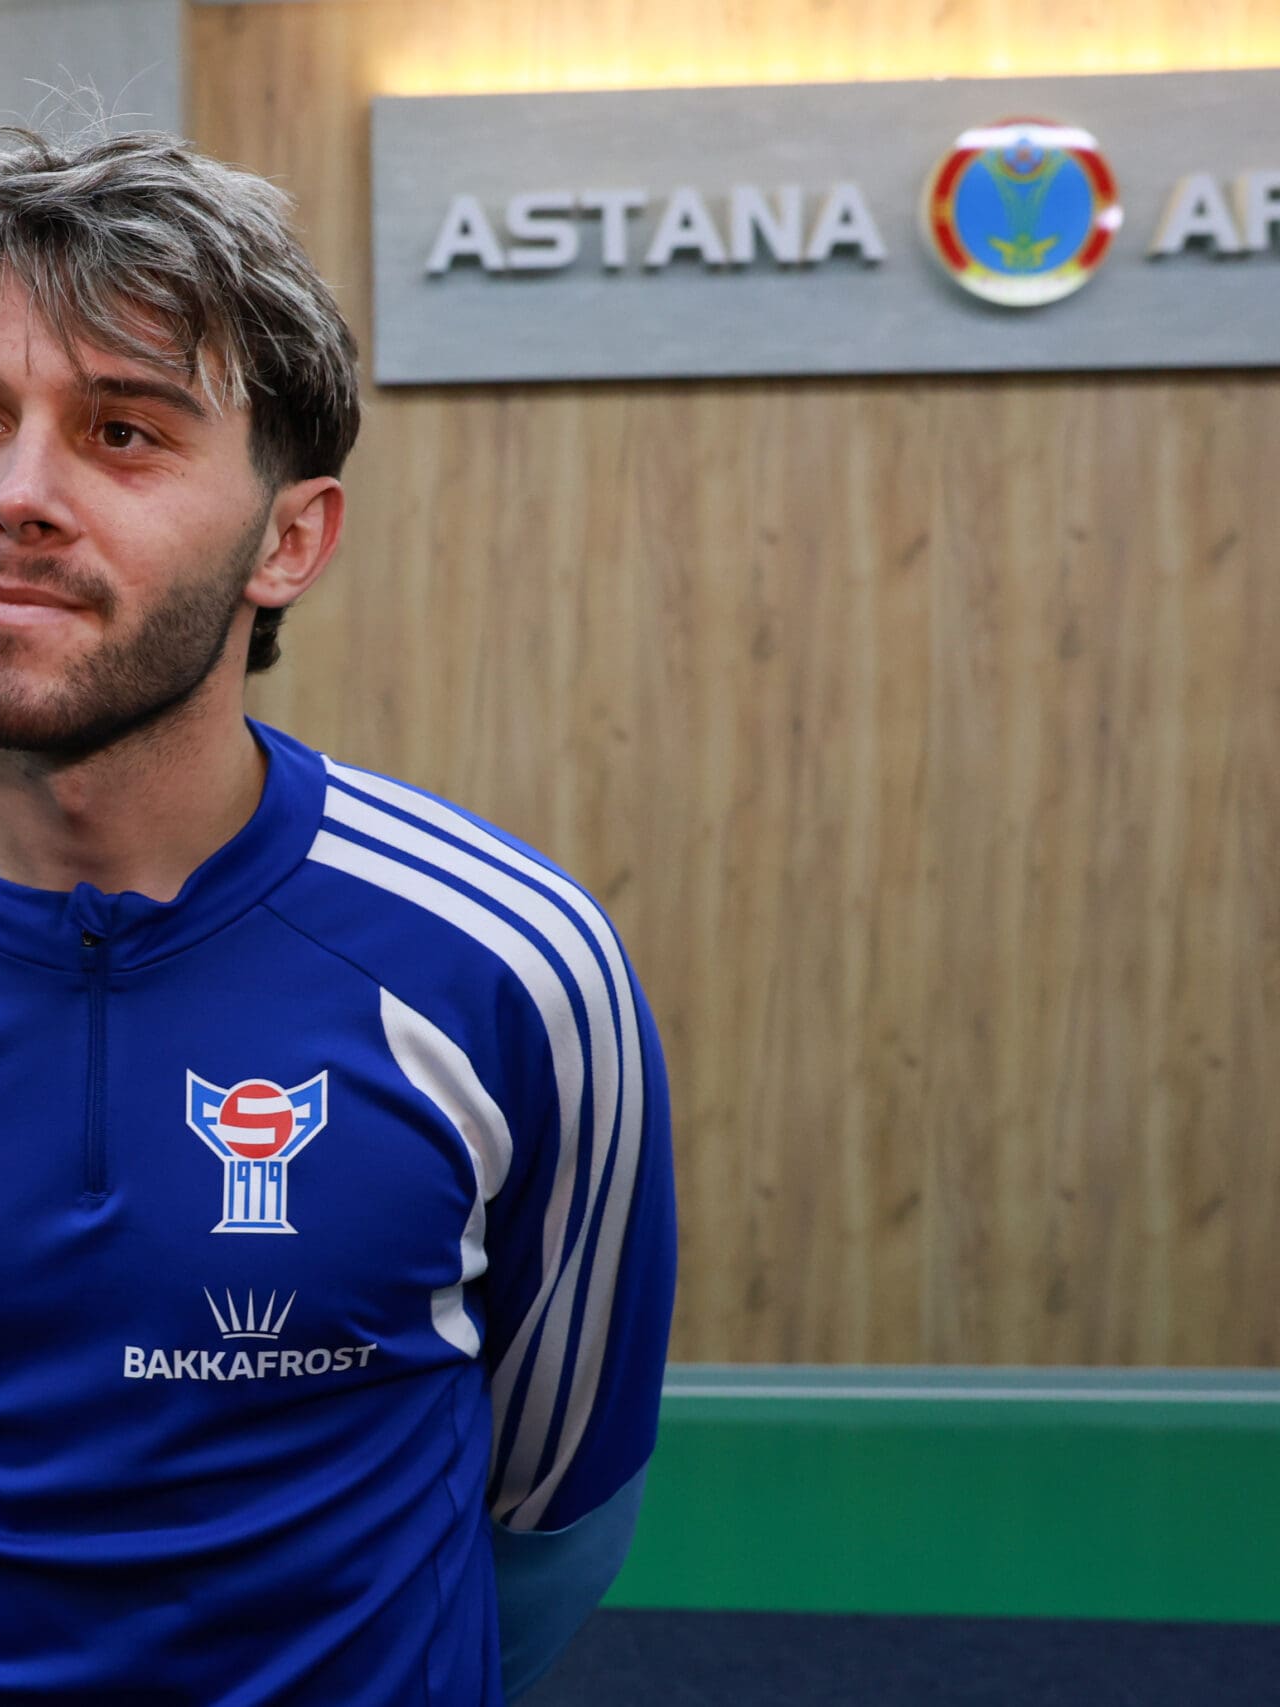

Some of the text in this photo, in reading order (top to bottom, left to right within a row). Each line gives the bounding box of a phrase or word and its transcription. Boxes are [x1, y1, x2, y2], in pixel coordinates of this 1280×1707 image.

[427, 183, 885, 273] ASTANA
[227, 1160, 283, 1221] 1979
[124, 1343, 377, 1381] BAKKAFROST
